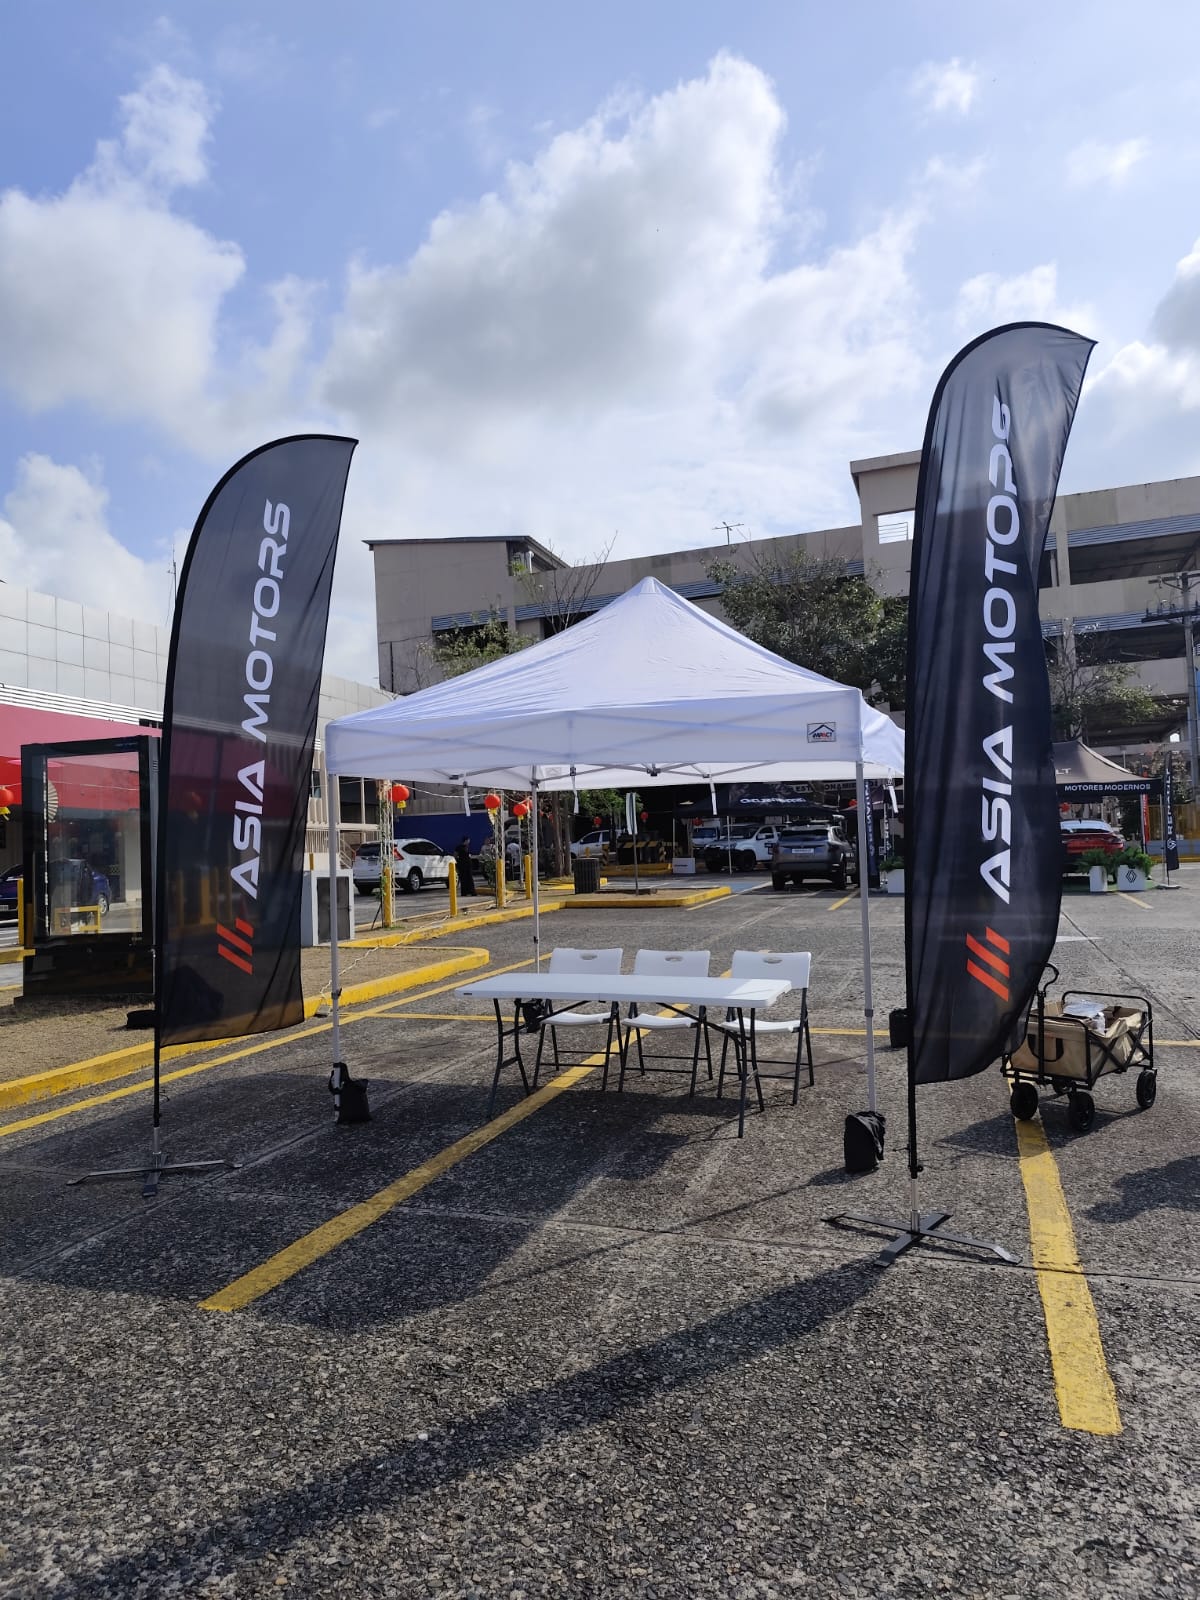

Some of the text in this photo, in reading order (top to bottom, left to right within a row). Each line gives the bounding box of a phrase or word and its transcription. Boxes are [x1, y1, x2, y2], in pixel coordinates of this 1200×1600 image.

[230, 498, 291, 900] ASIA MOTORS
[1104, 783, 1151, 791] MODERNOS
[979, 723, 1013, 905] ASIA
